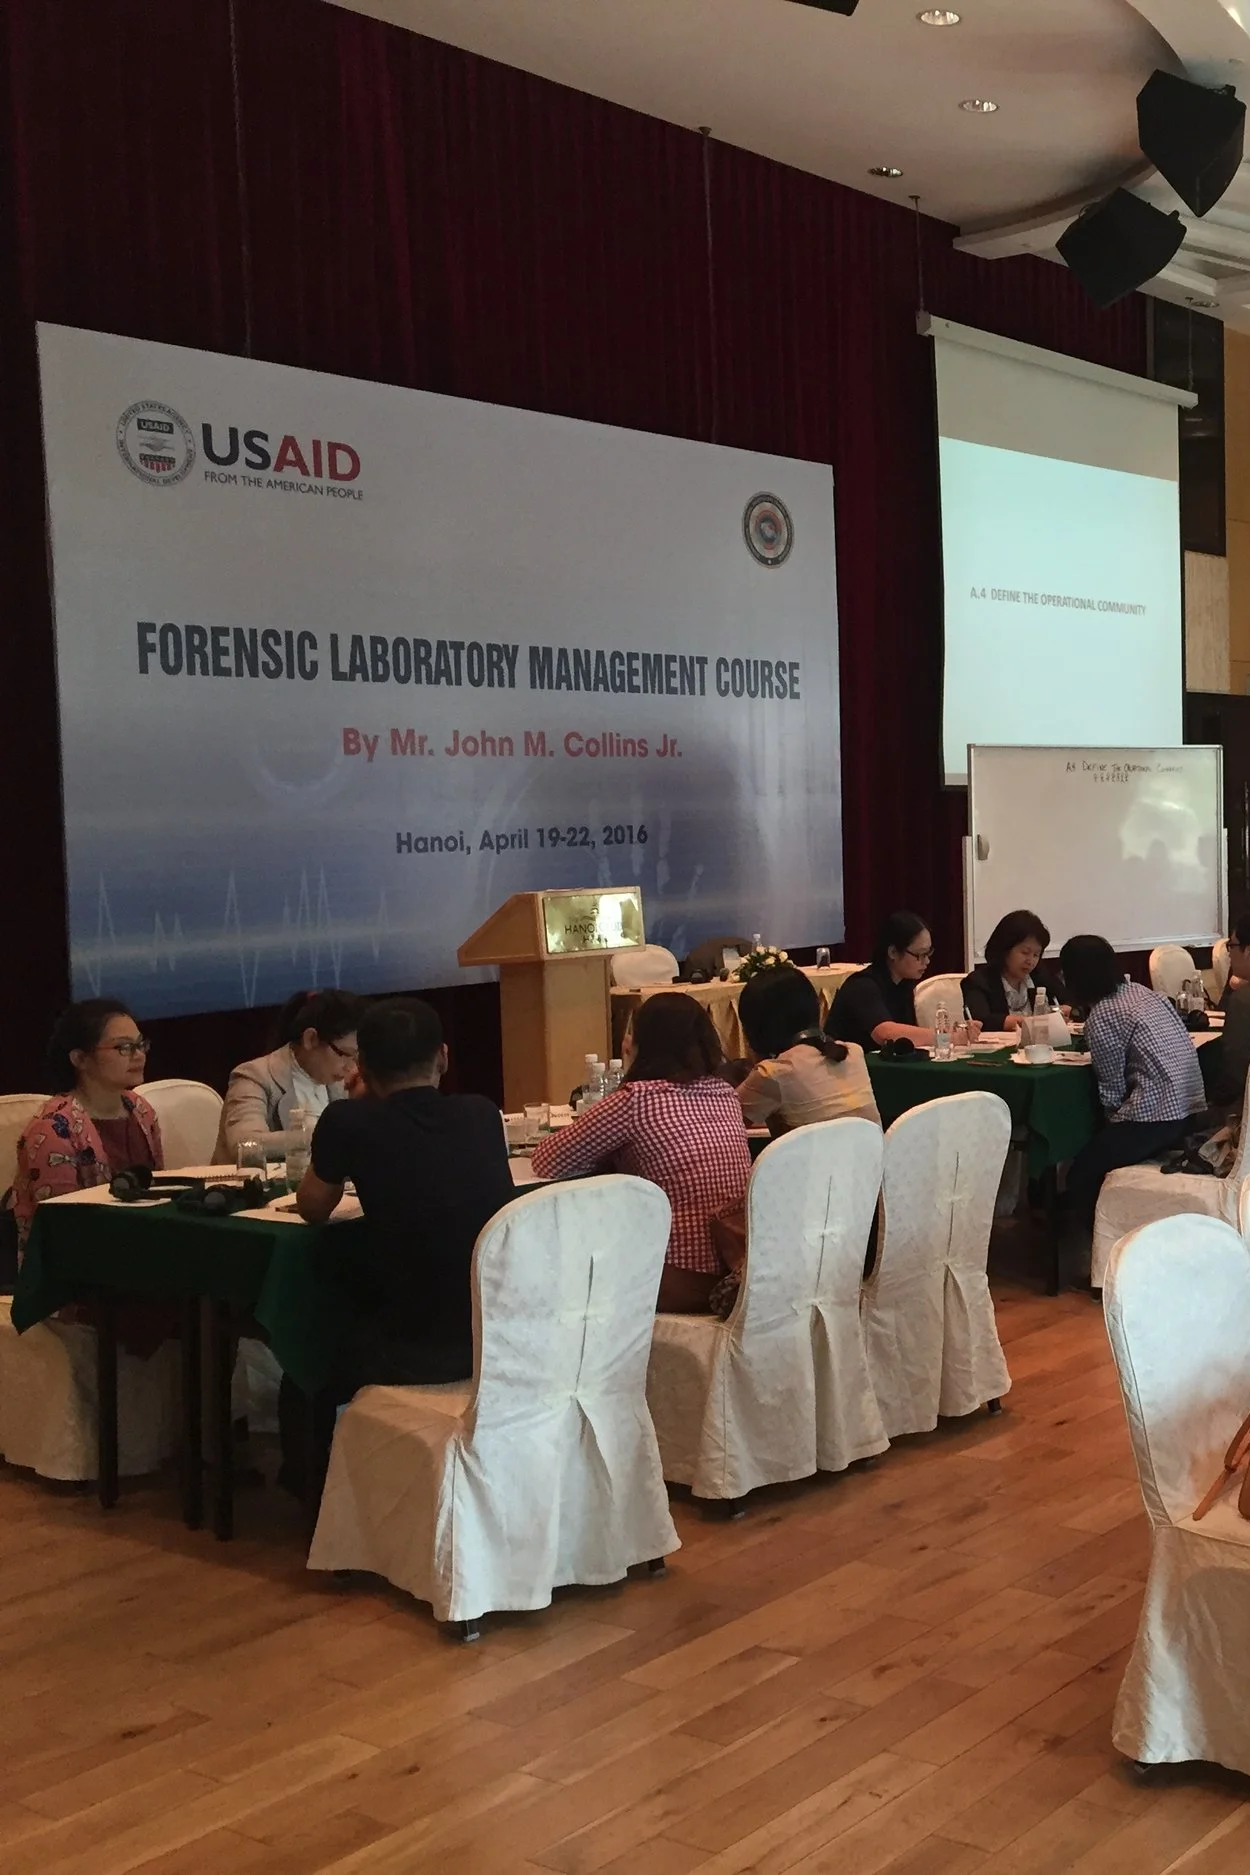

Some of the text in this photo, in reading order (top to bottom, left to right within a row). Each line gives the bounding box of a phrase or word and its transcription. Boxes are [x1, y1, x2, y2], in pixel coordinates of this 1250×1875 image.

[140, 420, 170, 432] USAID
[202, 423, 361, 482] USAID
[204, 471, 364, 501] FROM THE AMERICAN PEOPLE
[970, 586, 1147, 617] A.4 DEFINE THE OPERATIONAL COMMUNITY
[137, 621, 801, 700] FORENSIC LABORATORY MANAGEMENT COURSE
[342, 727, 683, 763] By Mr. John M. Collins Jr.
[396, 824, 648, 855] Hanoi, April 19-22, 2016
